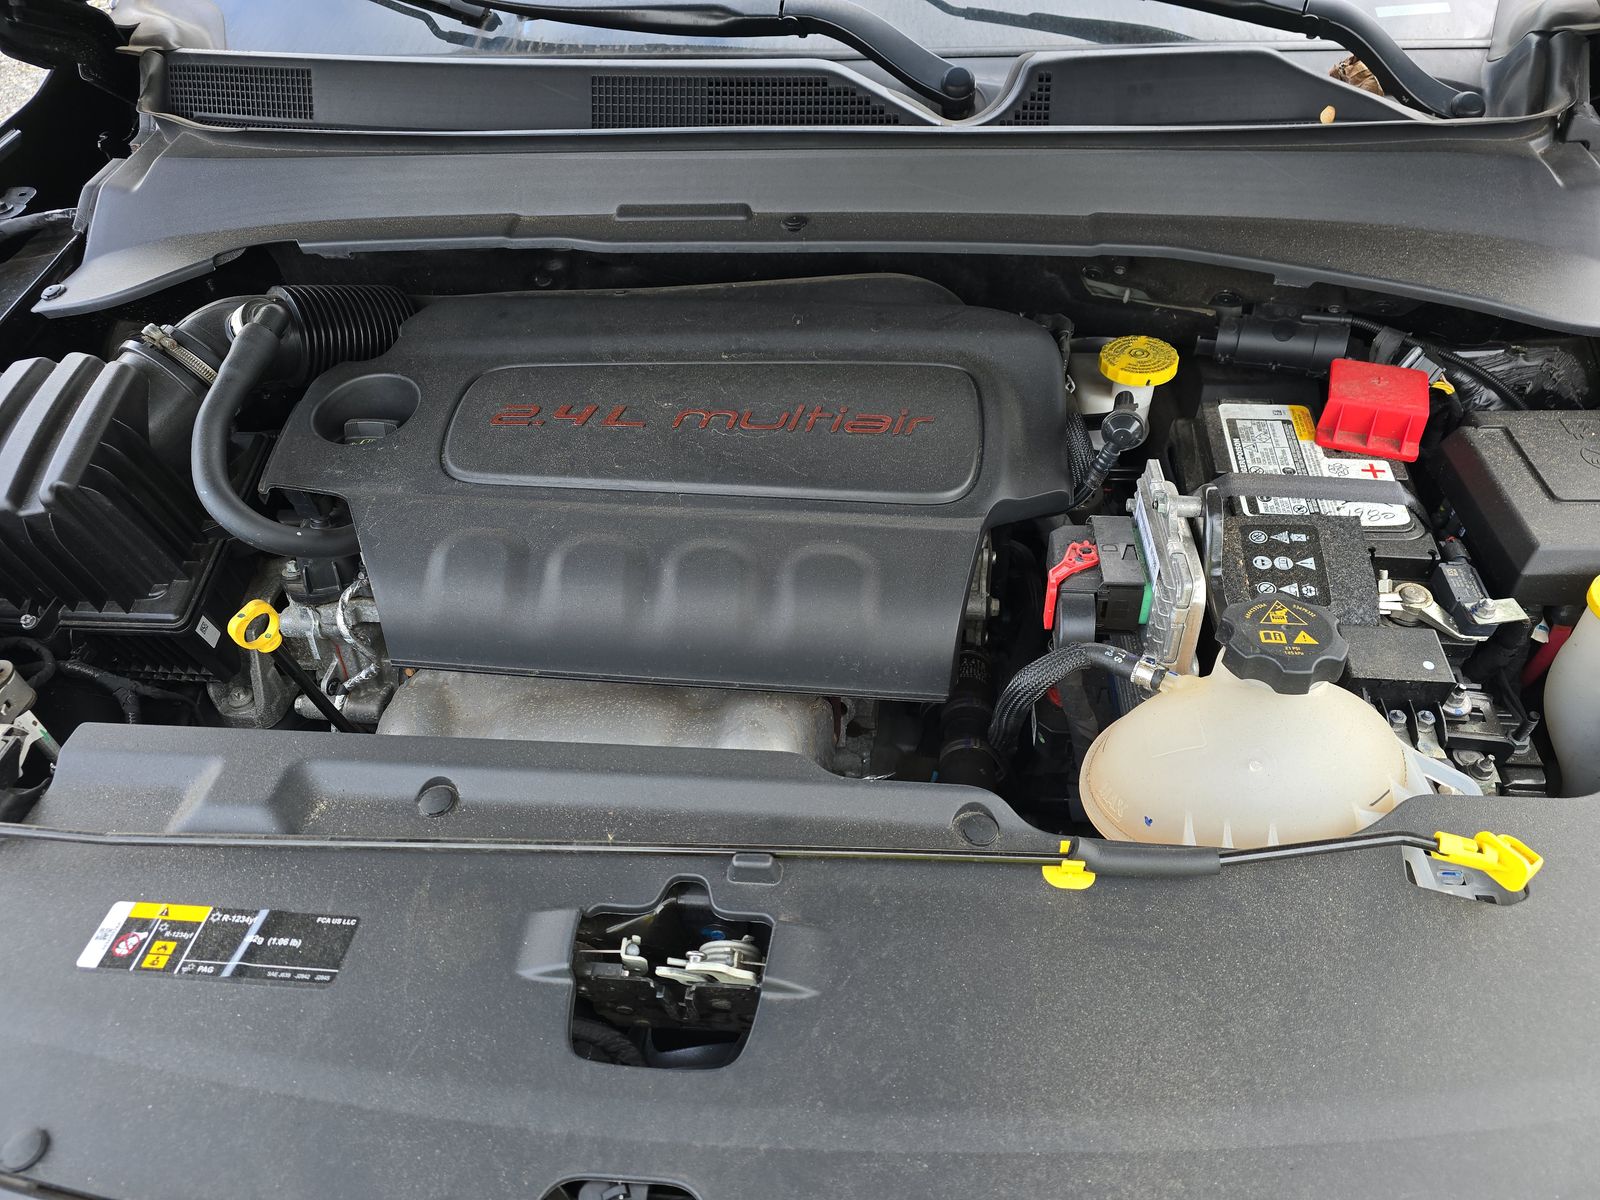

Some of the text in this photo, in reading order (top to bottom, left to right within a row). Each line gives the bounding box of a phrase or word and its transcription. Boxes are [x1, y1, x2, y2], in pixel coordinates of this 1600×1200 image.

[491, 404, 936, 436] 2.4L multiair
[221, 913, 258, 926] R-1234yf
[316, 916, 331, 925] FCA
[343, 918, 357, 926] LLC
[164, 931, 193, 939] R-1234yf
[289, 937, 302, 949] lb)
[197, 965, 214, 974] PAG
